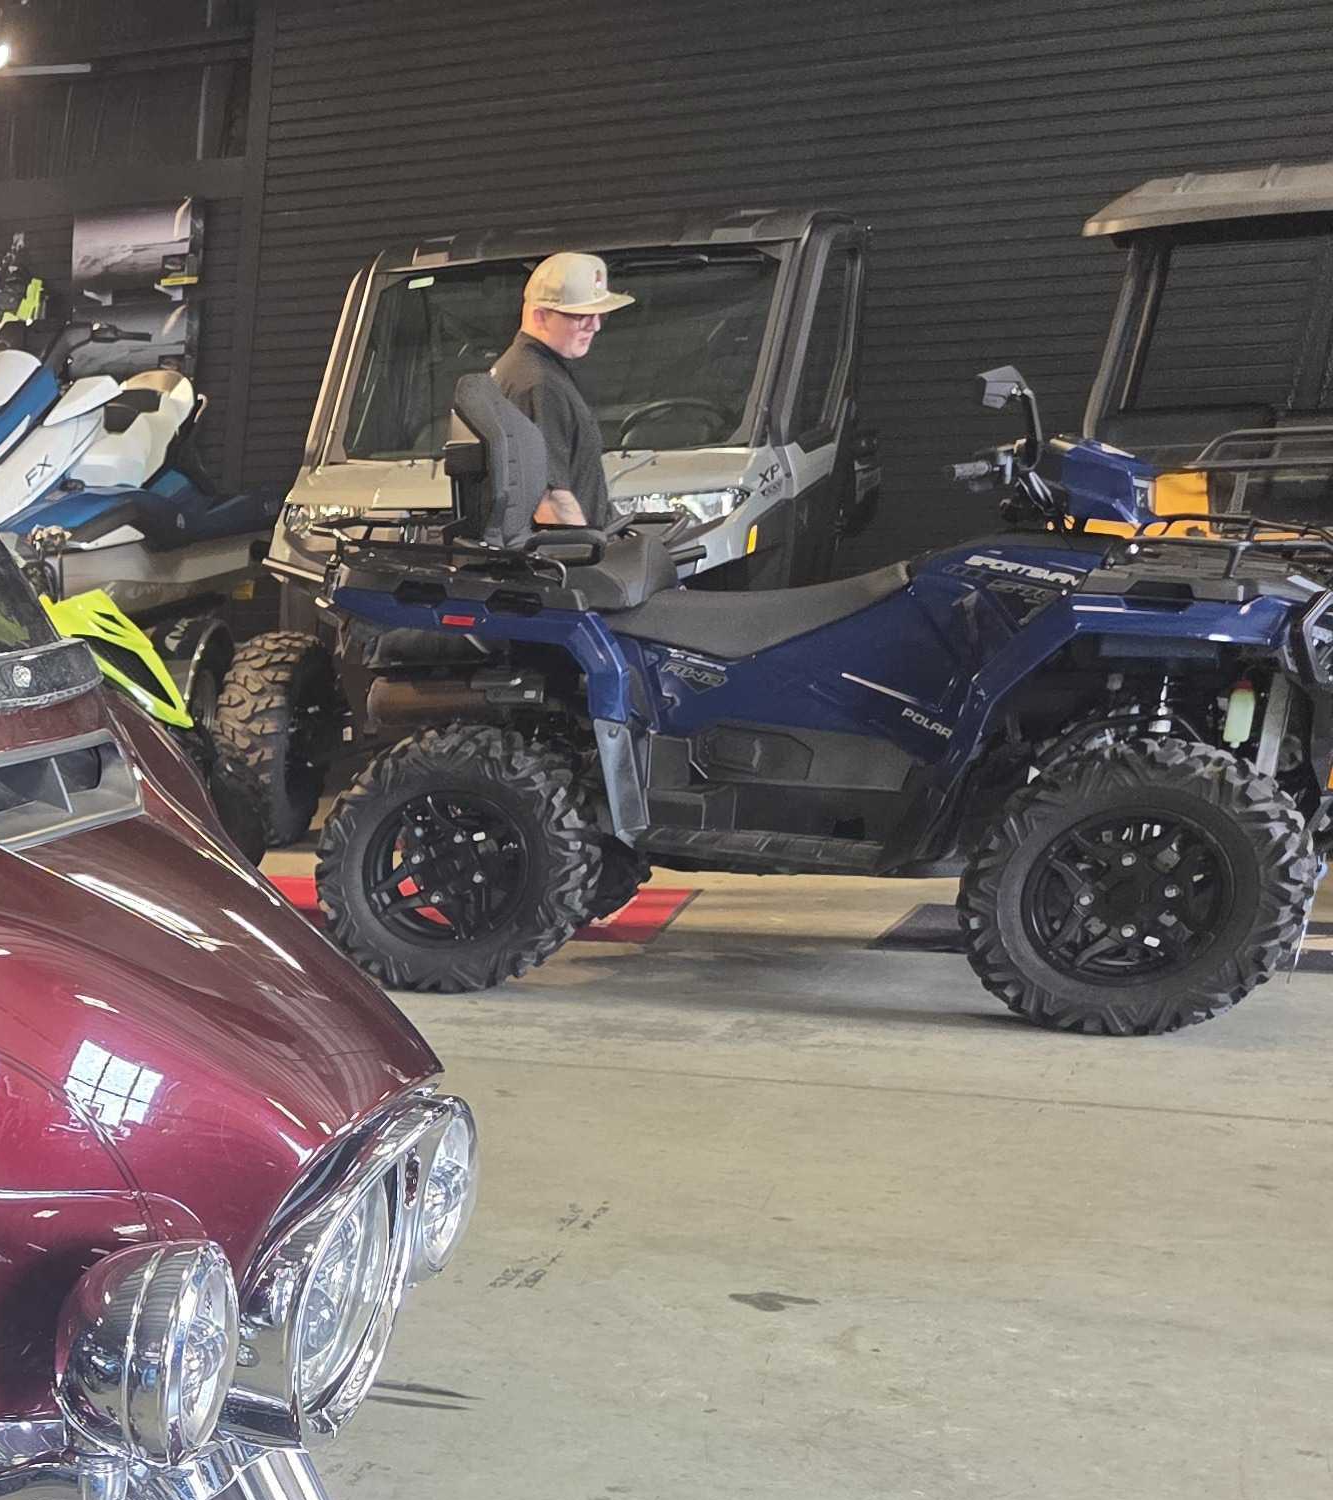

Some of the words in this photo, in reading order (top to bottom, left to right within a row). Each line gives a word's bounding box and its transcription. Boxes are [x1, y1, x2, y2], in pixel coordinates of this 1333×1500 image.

[25, 454, 52, 487] FX
[759, 463, 780, 488] XP
[901, 707, 953, 739] POLAR
